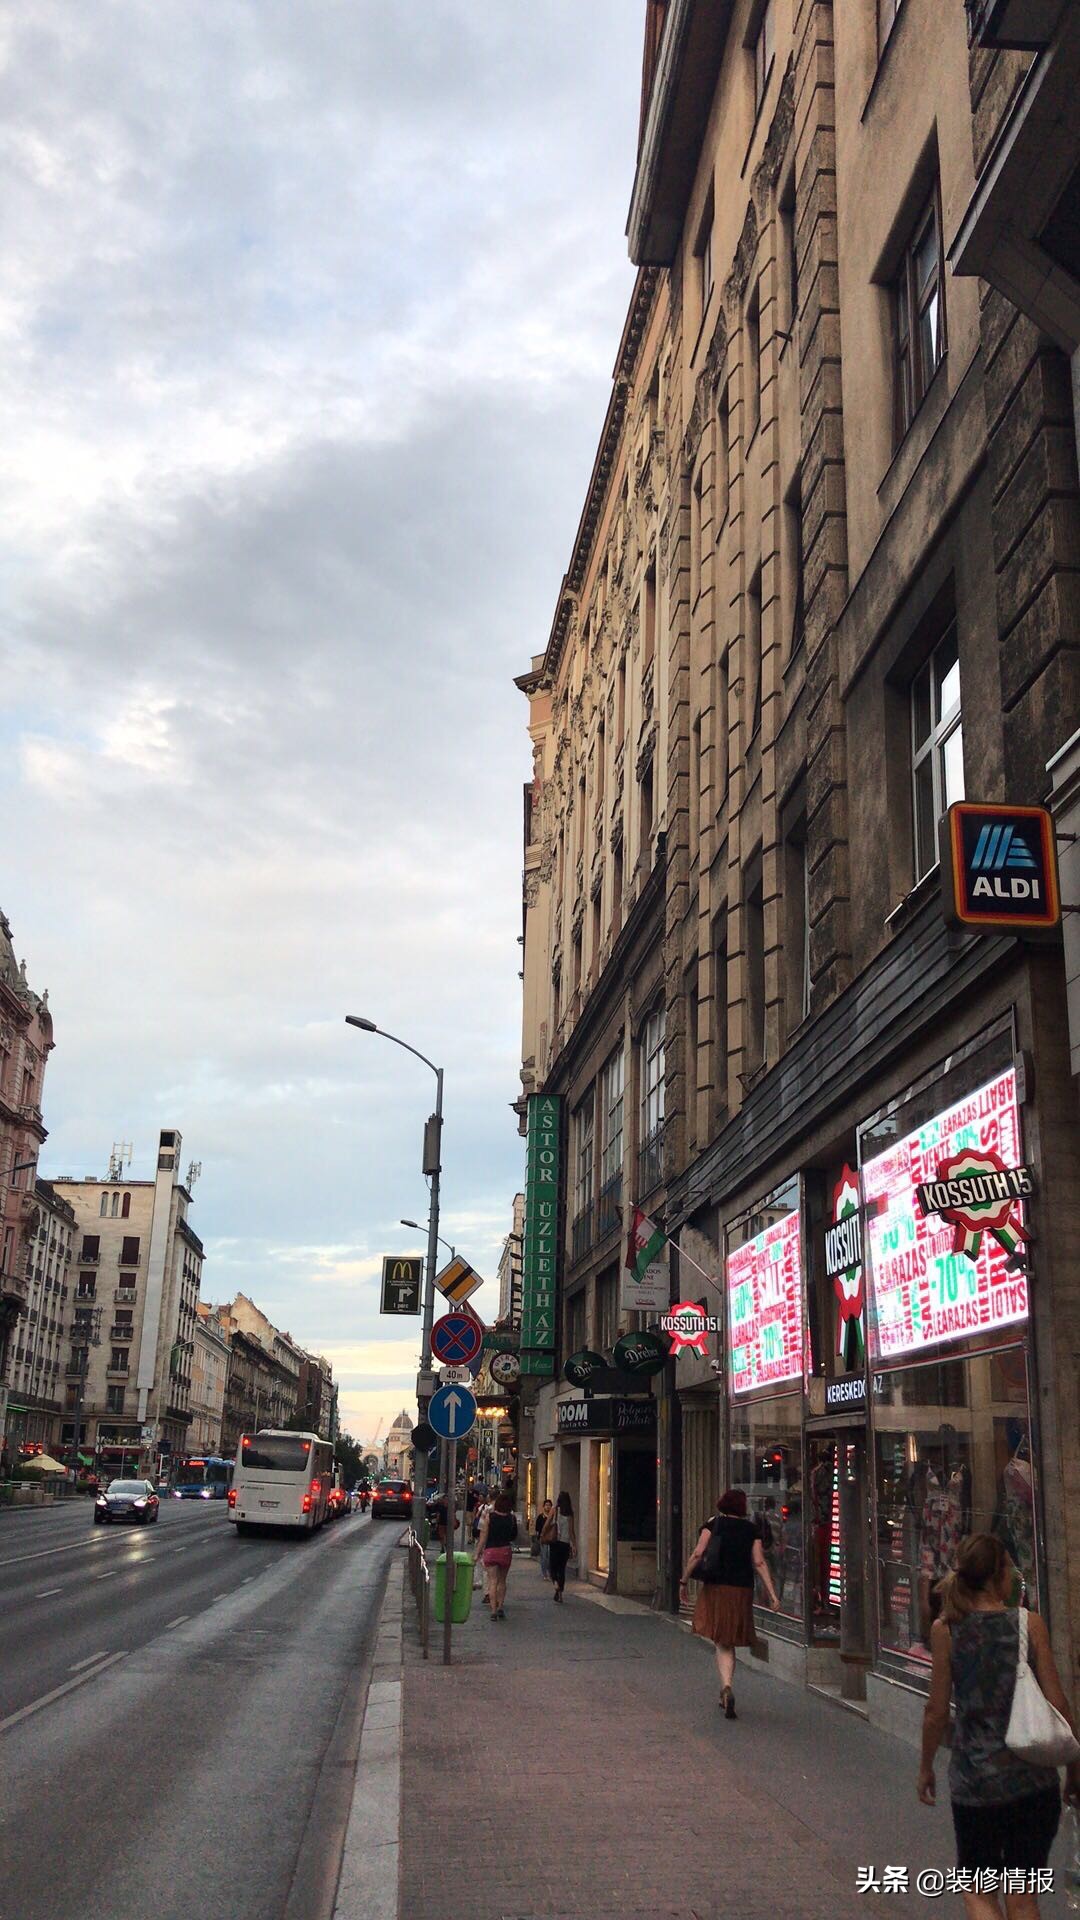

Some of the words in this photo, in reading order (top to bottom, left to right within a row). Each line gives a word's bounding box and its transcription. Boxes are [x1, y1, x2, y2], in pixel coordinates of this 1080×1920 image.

[972, 876, 1040, 900] ALDI
[540, 1099, 554, 1181] ASTOR
[922, 1173, 1010, 1210] KOSSUTH
[1009, 1168, 1032, 1194] 15
[535, 1201, 552, 1345] ÜZLETHÁZ
[931, 1252, 977, 1305] -70%
[661, 1316, 705, 1331] KOSSUTH
[706, 1316, 717, 1331] 15
[559, 1404, 588, 1422] OOM
